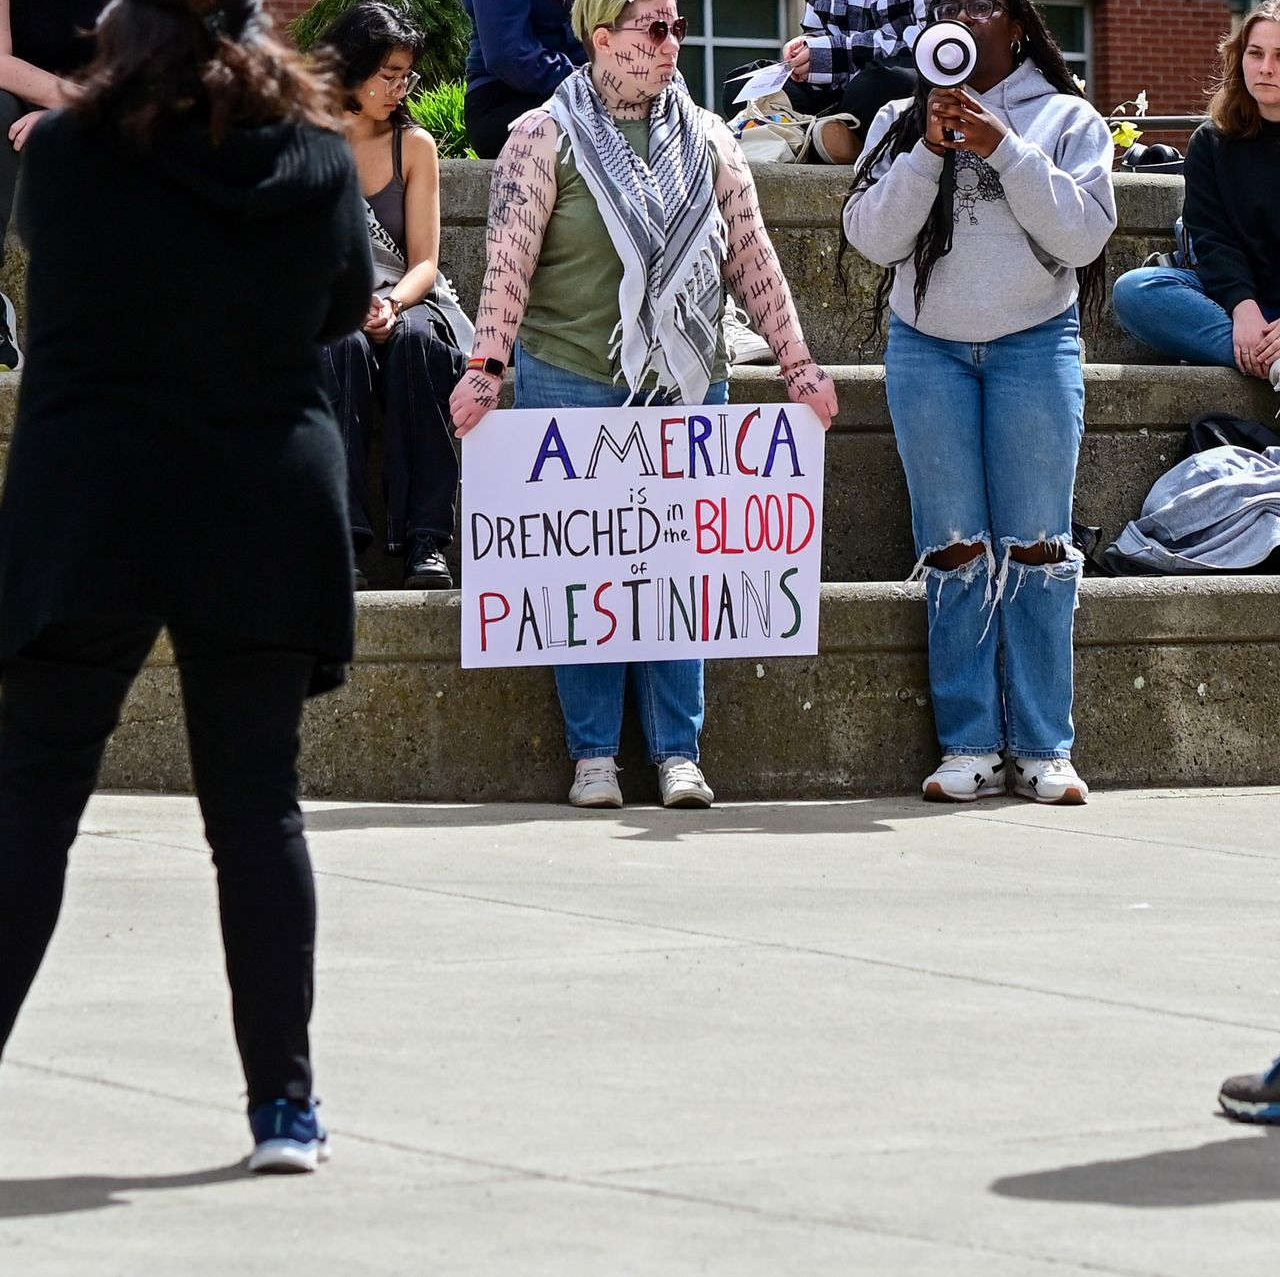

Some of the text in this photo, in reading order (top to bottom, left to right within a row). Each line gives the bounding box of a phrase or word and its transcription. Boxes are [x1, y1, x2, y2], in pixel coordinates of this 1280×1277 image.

[525, 406, 806, 483] AMERICA
[471, 492, 816, 561] DRENCHED in the BLOOD
[629, 486, 648, 505] is
[630, 561, 648, 575] of
[479, 567, 803, 652] PALESTINIANS
